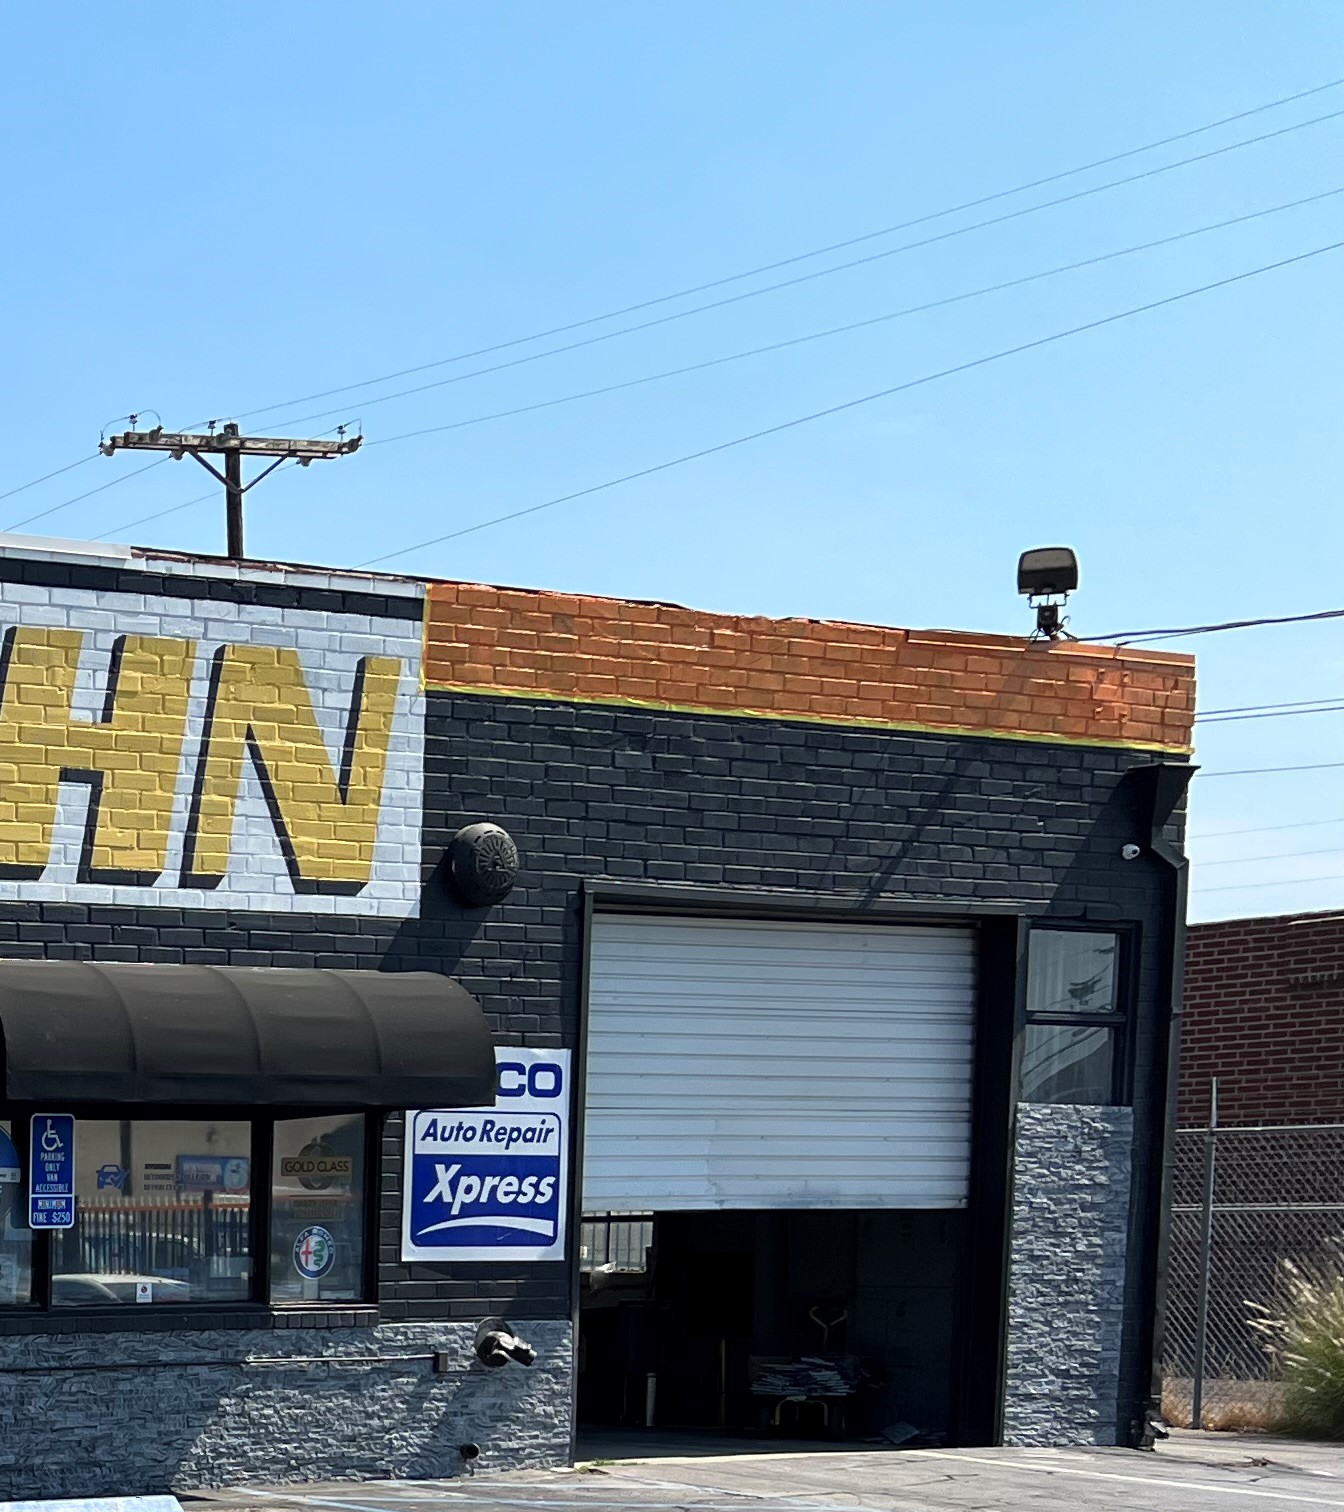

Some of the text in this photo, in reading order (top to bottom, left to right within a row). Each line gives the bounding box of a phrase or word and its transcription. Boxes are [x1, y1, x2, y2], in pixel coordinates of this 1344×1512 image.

[421, 1119, 554, 1150] Auto Repair
[40, 1152, 65, 1162] PARKING
[45, 1162, 61, 1172] ONLY
[285, 1160, 349, 1173] GOLD CLASS
[46, 1173, 58, 1182] VAN
[35, 1183, 69, 1192] ACCESSIBLE
[423, 1164, 556, 1215] Xpress
[33, 1211, 71, 1223] FINE $250
